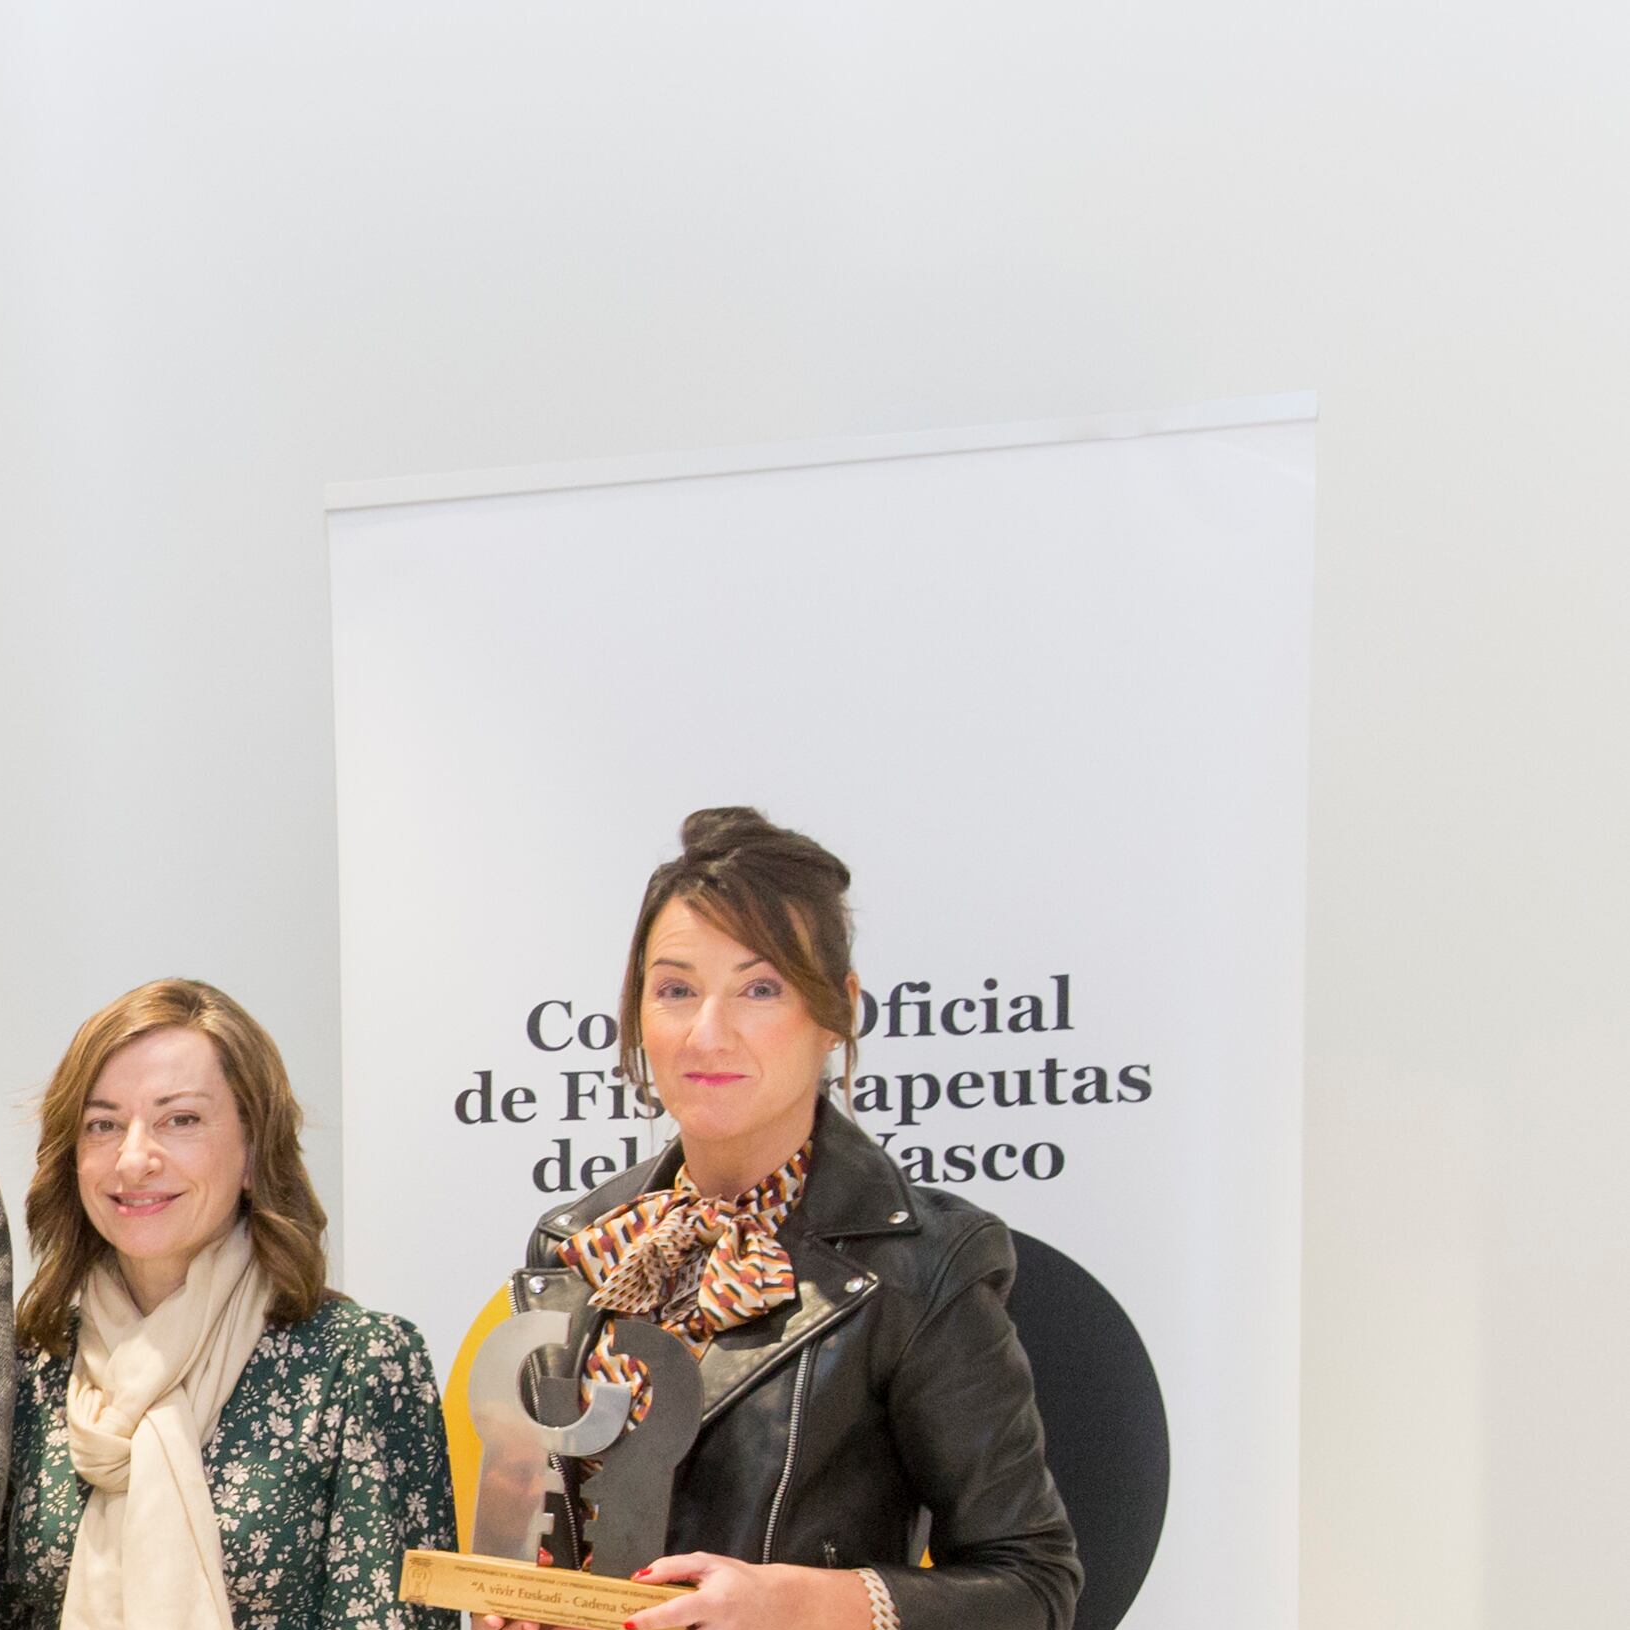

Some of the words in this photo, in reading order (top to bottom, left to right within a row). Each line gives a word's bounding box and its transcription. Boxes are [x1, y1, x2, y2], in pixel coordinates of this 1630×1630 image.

[526, 1000, 618, 1052] Co
[454, 1070, 538, 1125] de
[559, 1066, 667, 1122] Fis
[828, 1057, 1153, 1127] apeutas
[876, 1132, 1065, 1184] asco
[489, 1584, 514, 1597] vivir
[518, 1588, 562, 1604] Euskadi
[573, 1596, 617, 1612] Cadena
